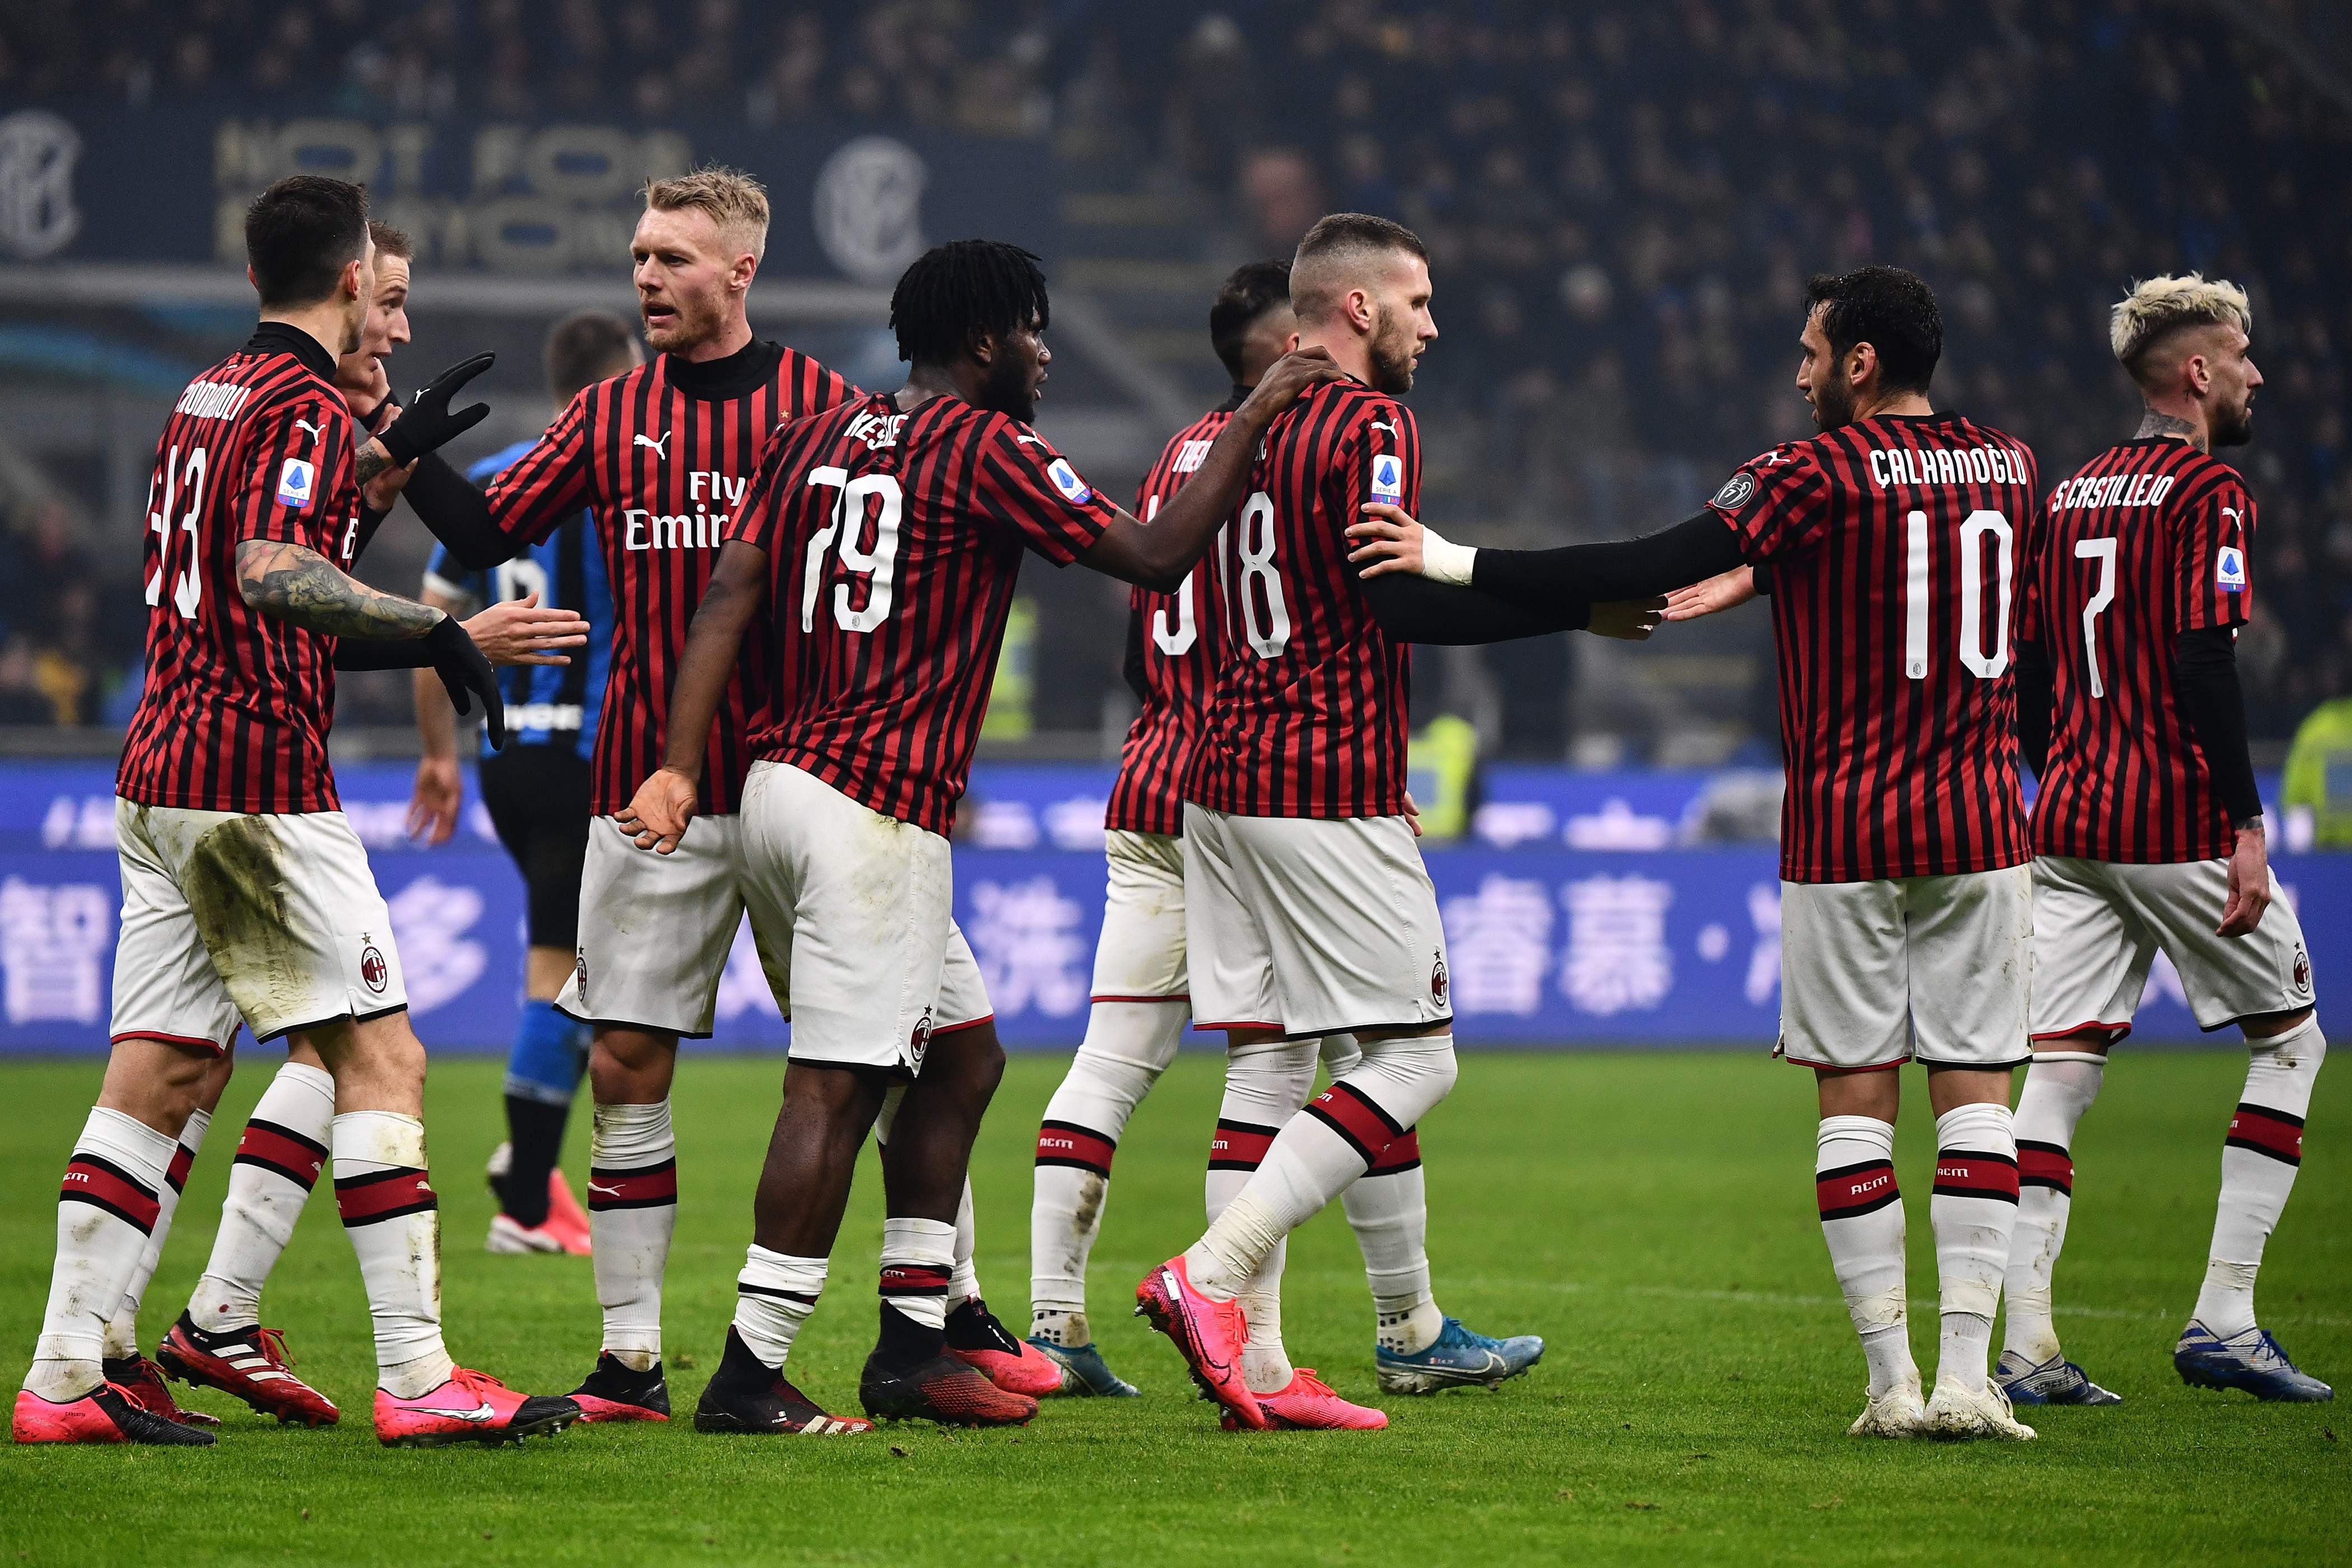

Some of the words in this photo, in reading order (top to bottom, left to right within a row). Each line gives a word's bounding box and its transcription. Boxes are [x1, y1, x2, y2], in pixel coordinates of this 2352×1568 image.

[1869, 443, 2027, 488] ÇALHANOĞLU
[689, 471, 746, 506] Fly
[623, 503, 733, 550] Emir
[802, 465, 903, 633] 79
[1217, 491, 1291, 661] 18
[1906, 510, 2013, 679] 10
[2075, 536, 2117, 698] 7
[1039, 1137, 1074, 1150] ACM
[1212, 1140, 1228, 1150] CM
[63, 1172, 90, 1183] CM
[1851, 1175, 1888, 1196] ACM
[1937, 1168, 1969, 1178] ACM
